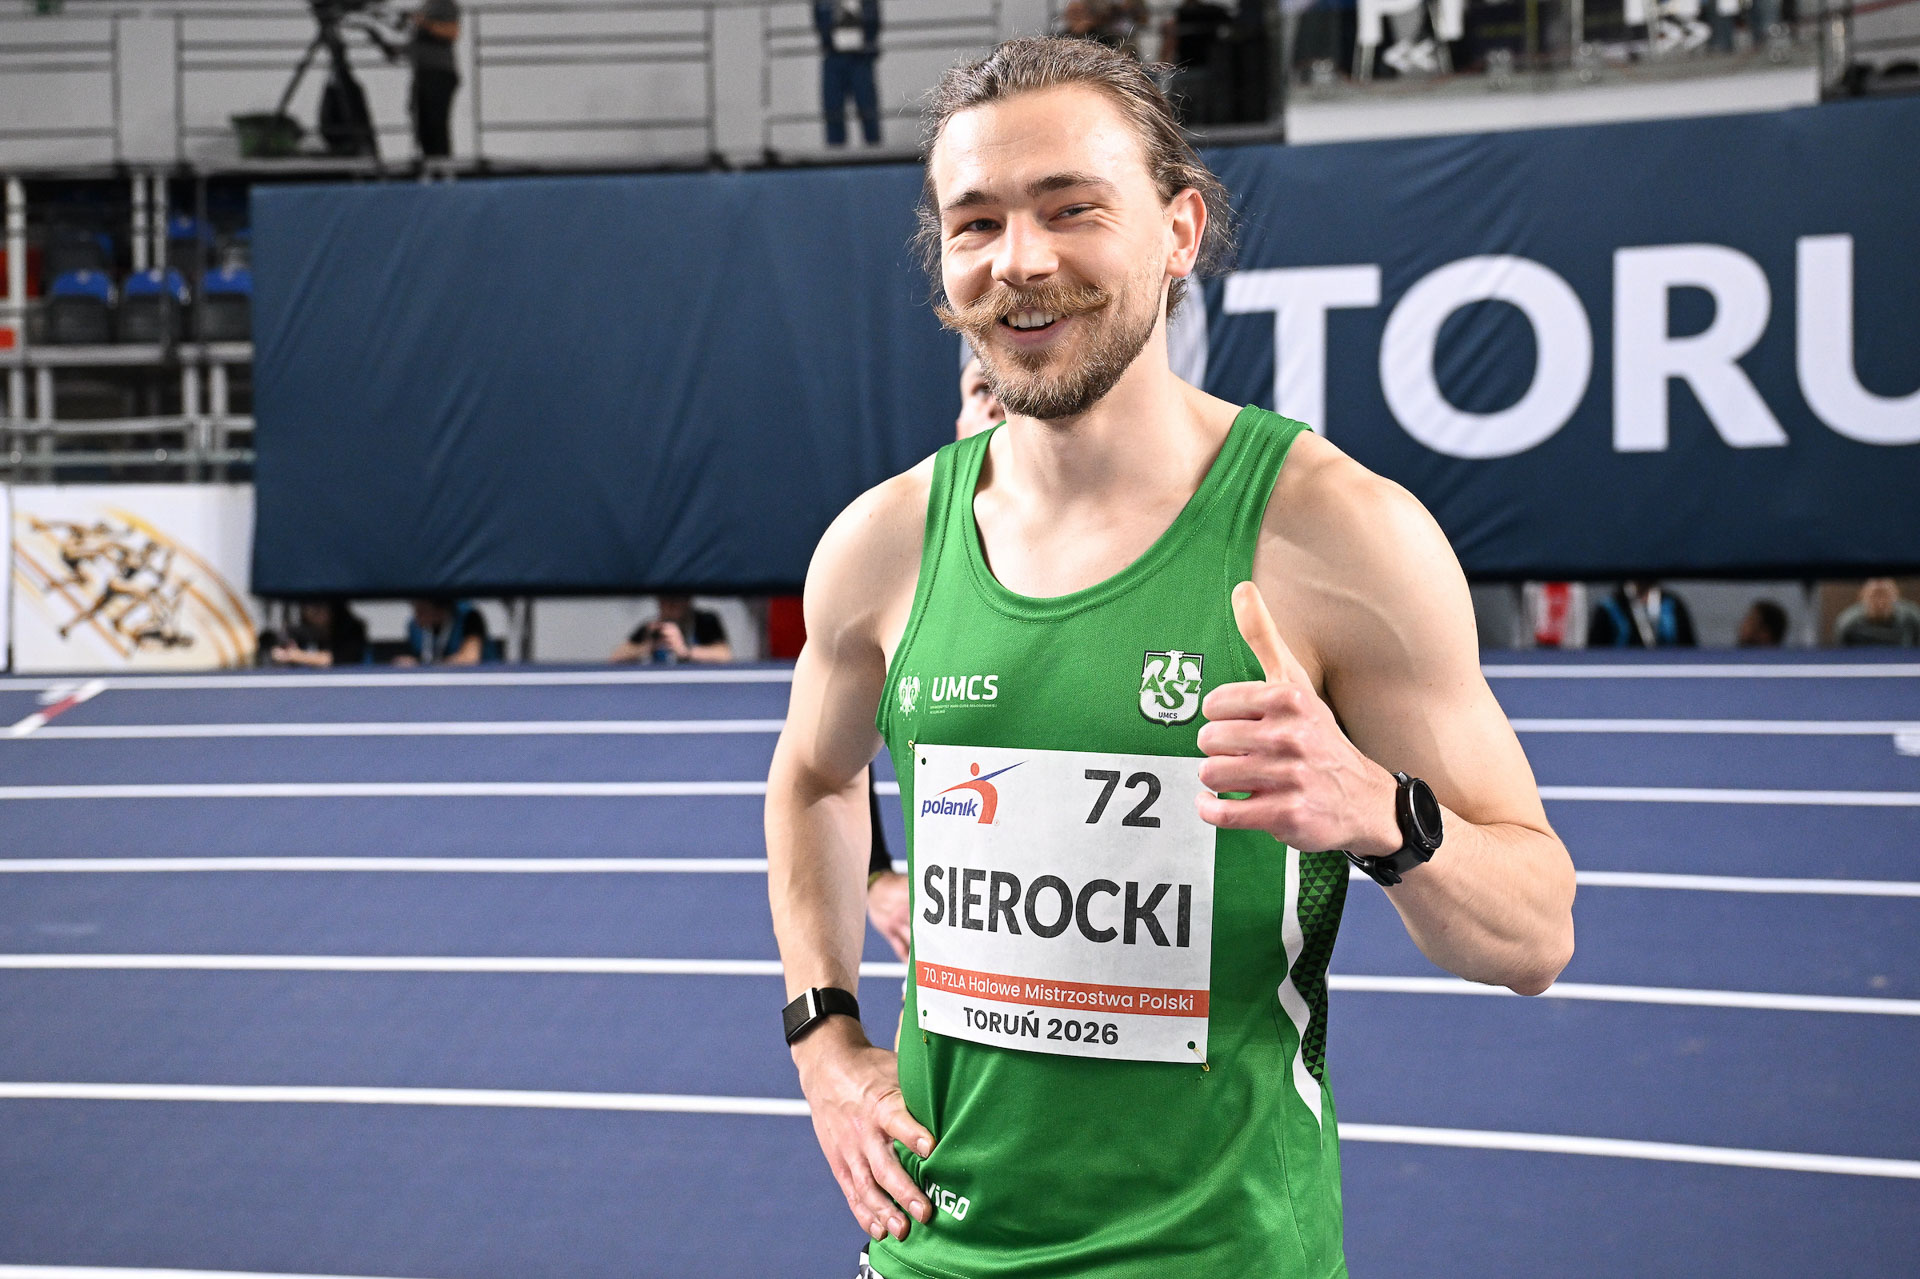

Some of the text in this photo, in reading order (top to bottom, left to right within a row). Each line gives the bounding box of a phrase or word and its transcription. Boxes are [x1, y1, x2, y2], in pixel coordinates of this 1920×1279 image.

[931, 674, 999, 702] UMCS
[1158, 711, 1178, 720] UMCS
[921, 796, 978, 818] polanik
[1084, 768, 1162, 828] 72
[923, 864, 1192, 948] SIEROCKI
[923, 966, 1194, 1012] 70. PZLA Halowe Mistrzostwa Polski
[963, 1006, 1119, 1046] TORUŃ 2026
